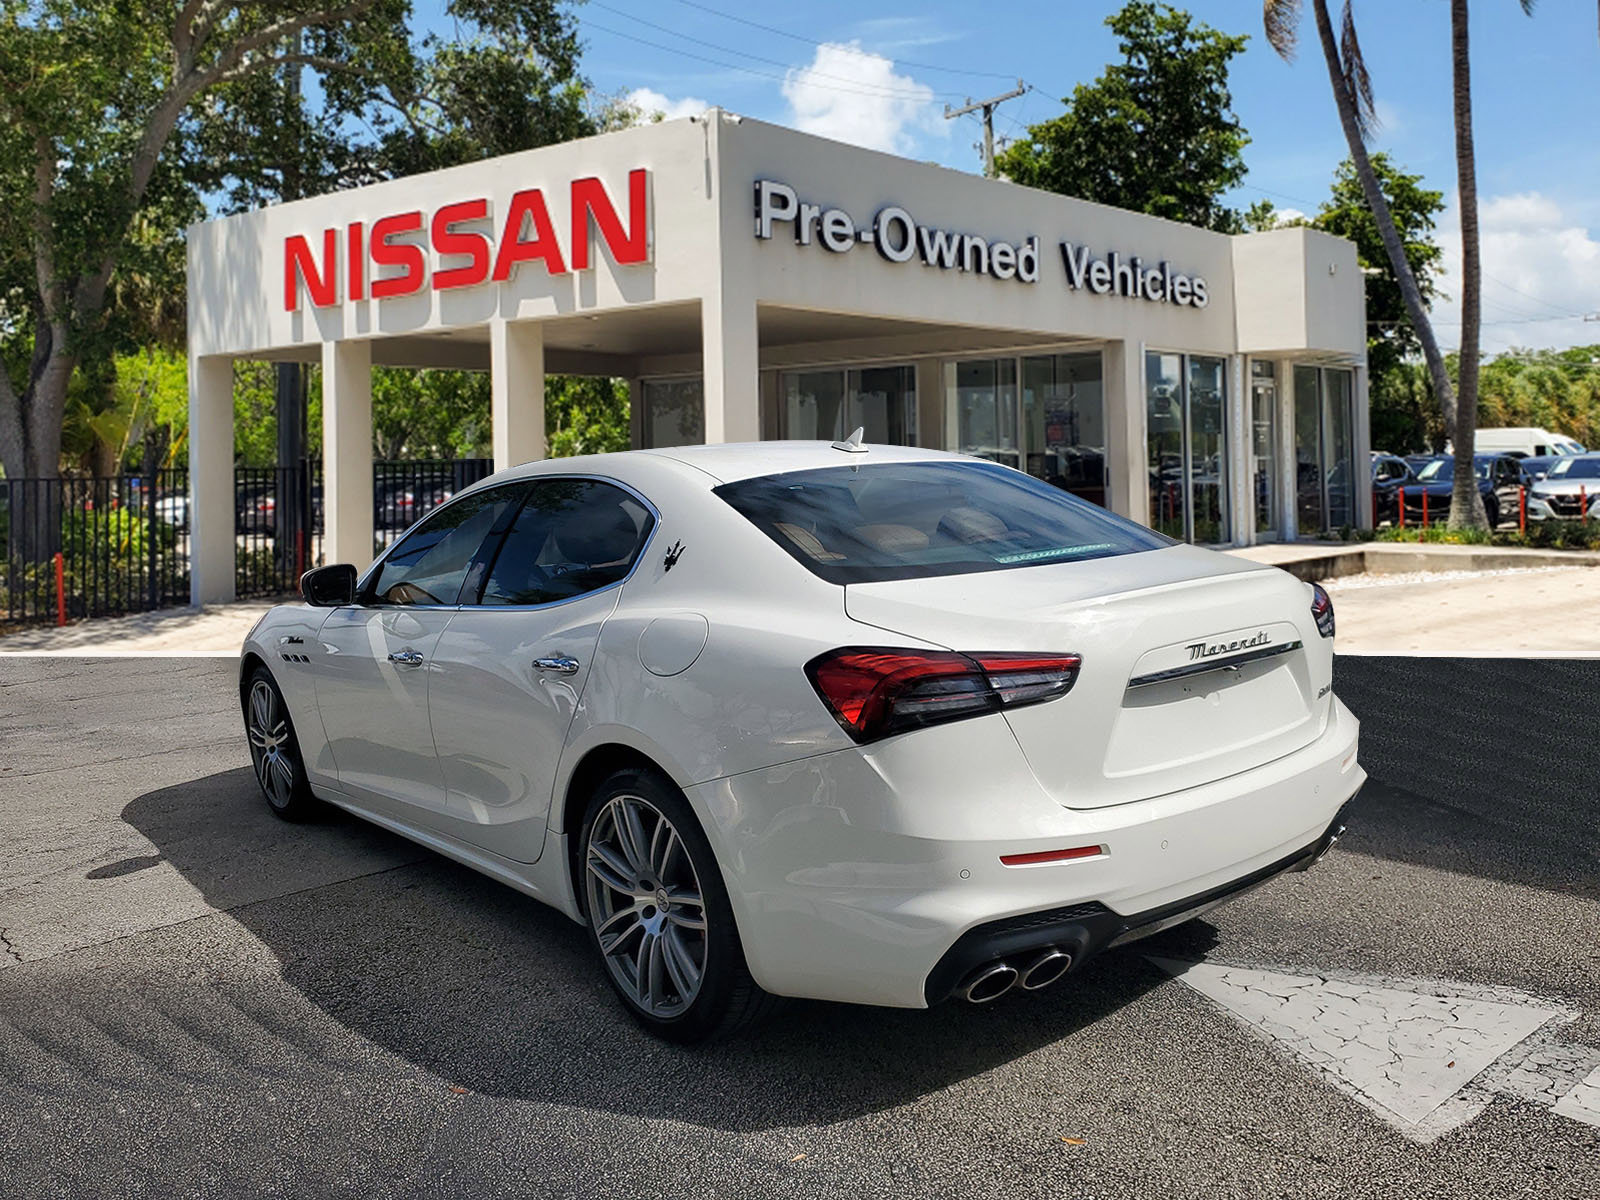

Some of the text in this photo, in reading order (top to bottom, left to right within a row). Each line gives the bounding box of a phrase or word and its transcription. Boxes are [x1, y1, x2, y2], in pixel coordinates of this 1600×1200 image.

[284, 168, 649, 312] NISSAN
[754, 179, 1210, 308] Pre-Owned Vehicles
[1184, 630, 1272, 660] Maserati
